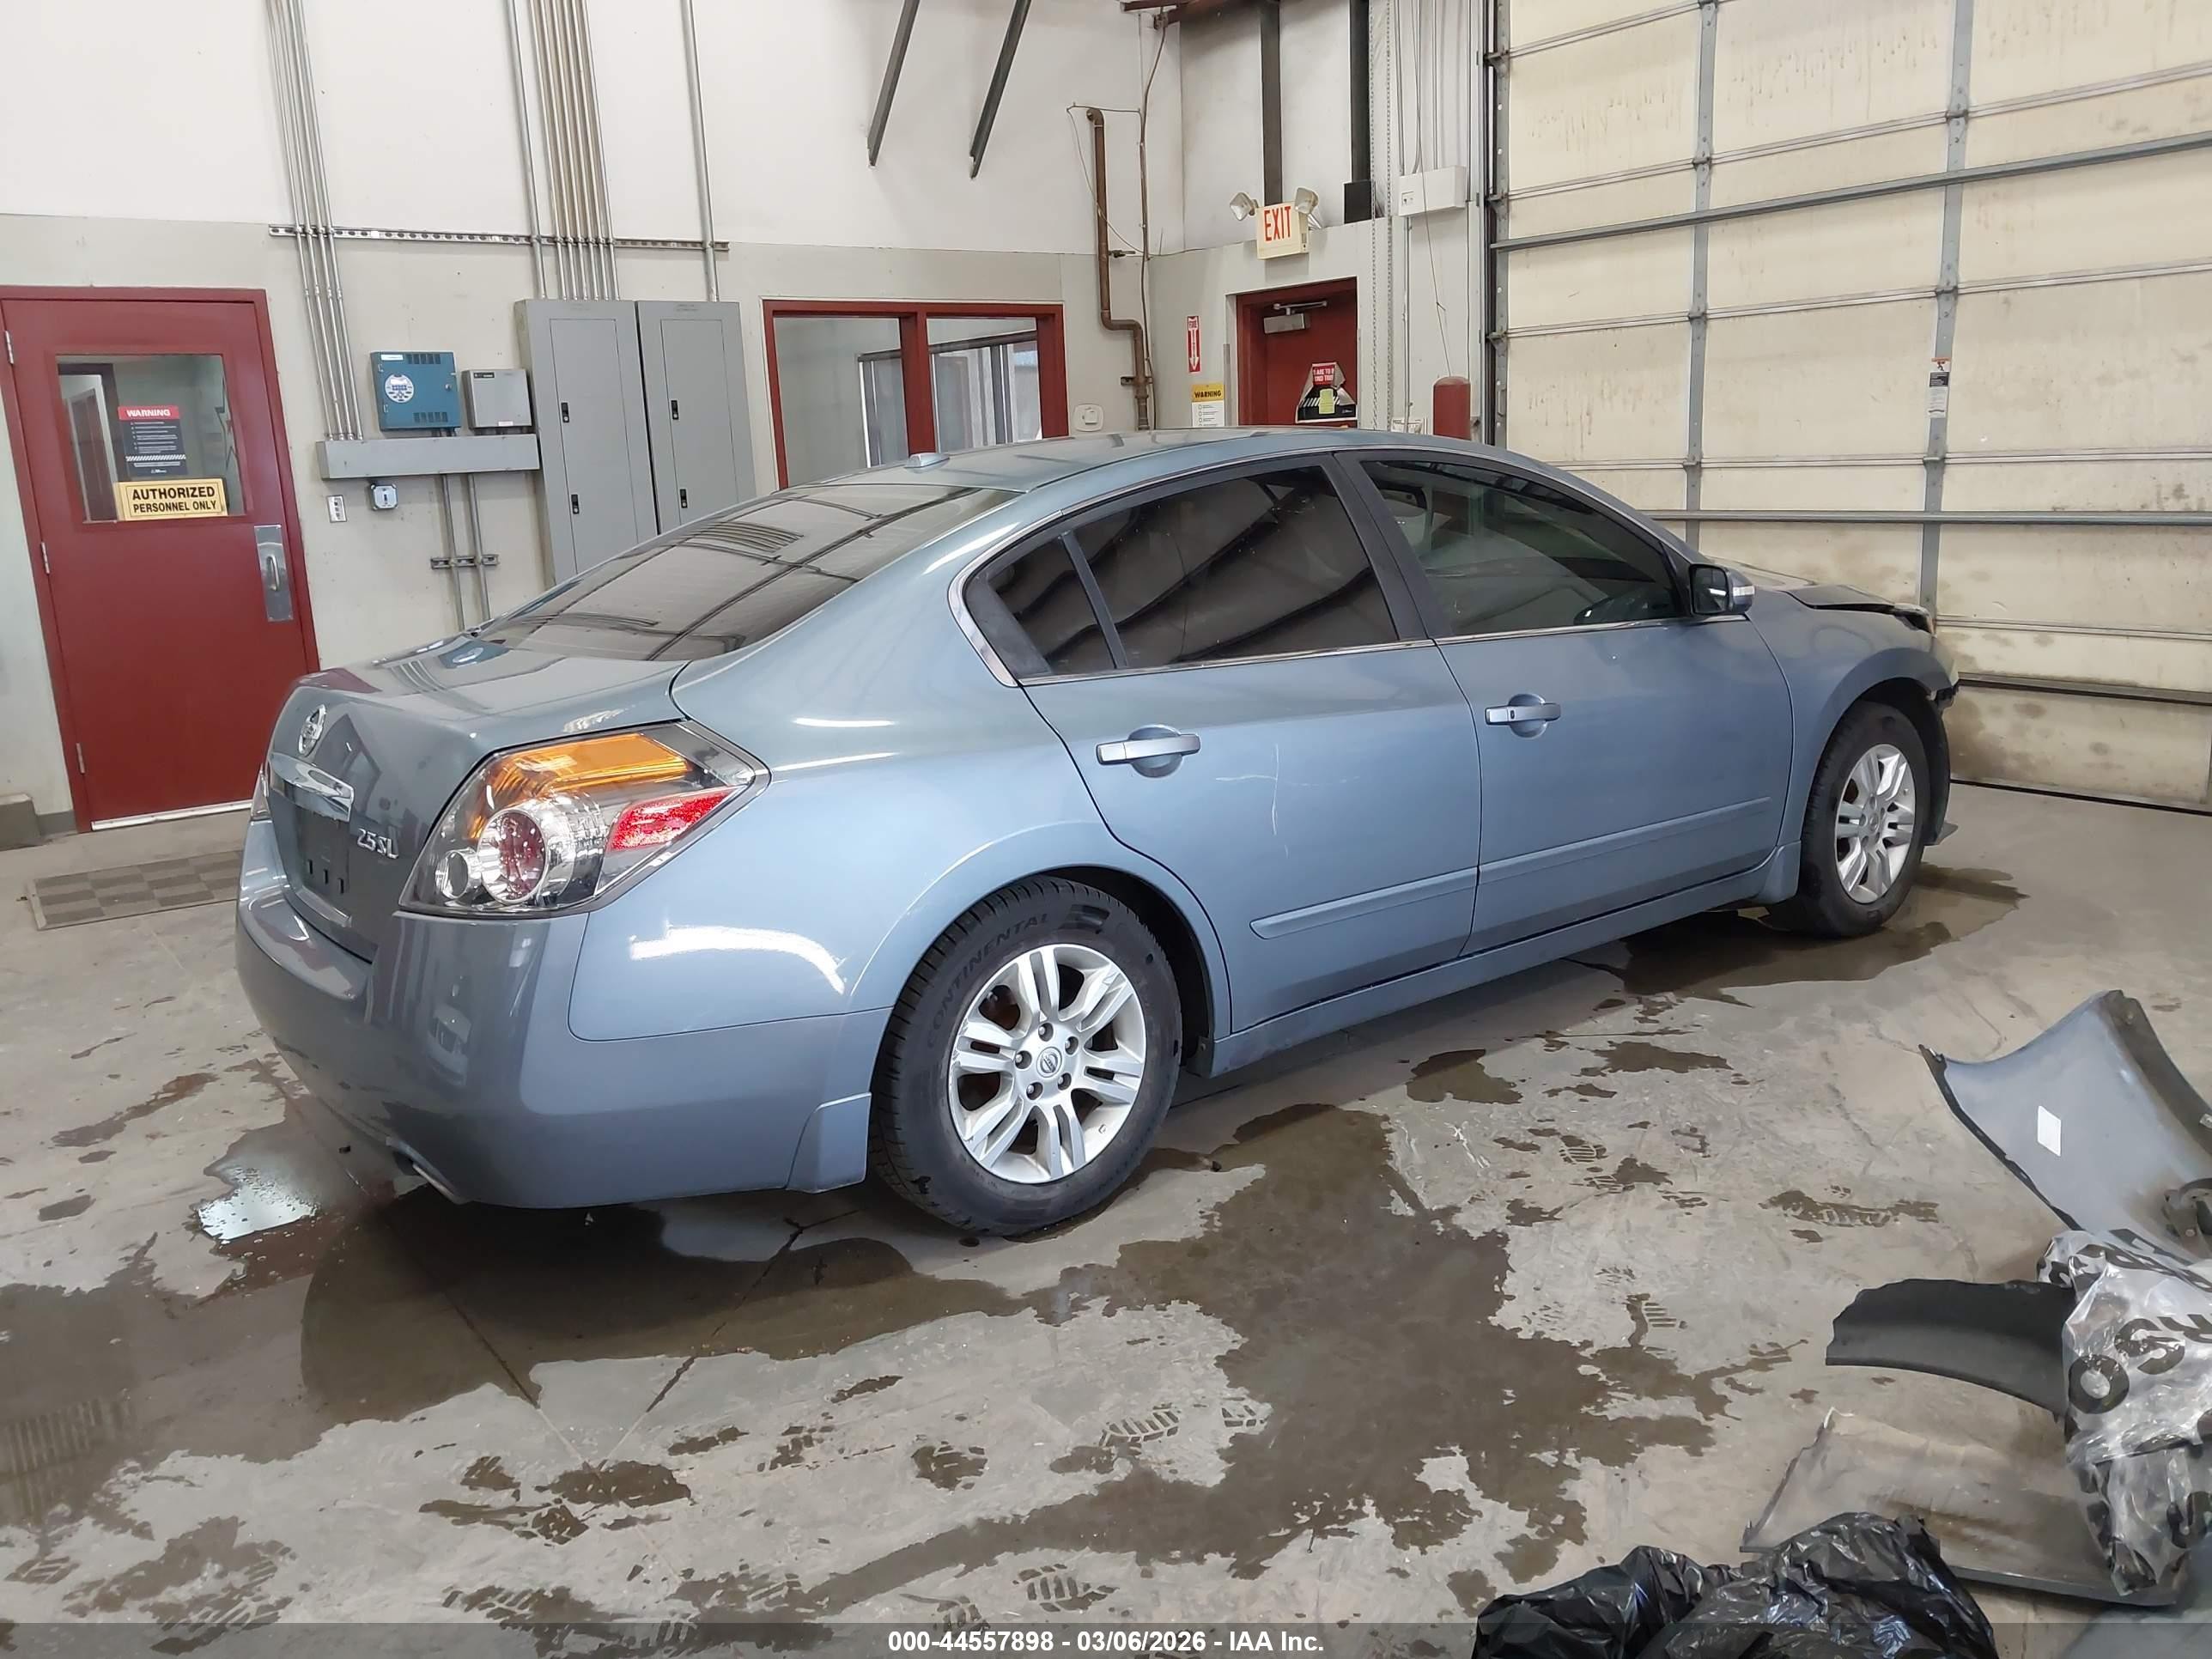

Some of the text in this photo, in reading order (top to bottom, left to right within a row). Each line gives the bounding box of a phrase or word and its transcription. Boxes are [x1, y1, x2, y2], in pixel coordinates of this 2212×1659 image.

[1264, 206, 1291, 241] EXIT
[1194, 390, 1222, 399] WARNING
[126, 409, 171, 417] WARNING
[132, 486, 216, 501] AUTHORIZED
[133, 500, 216, 514] PERSONNEL ONLY
[927, 912, 1048, 1048] CONTINENTAL
